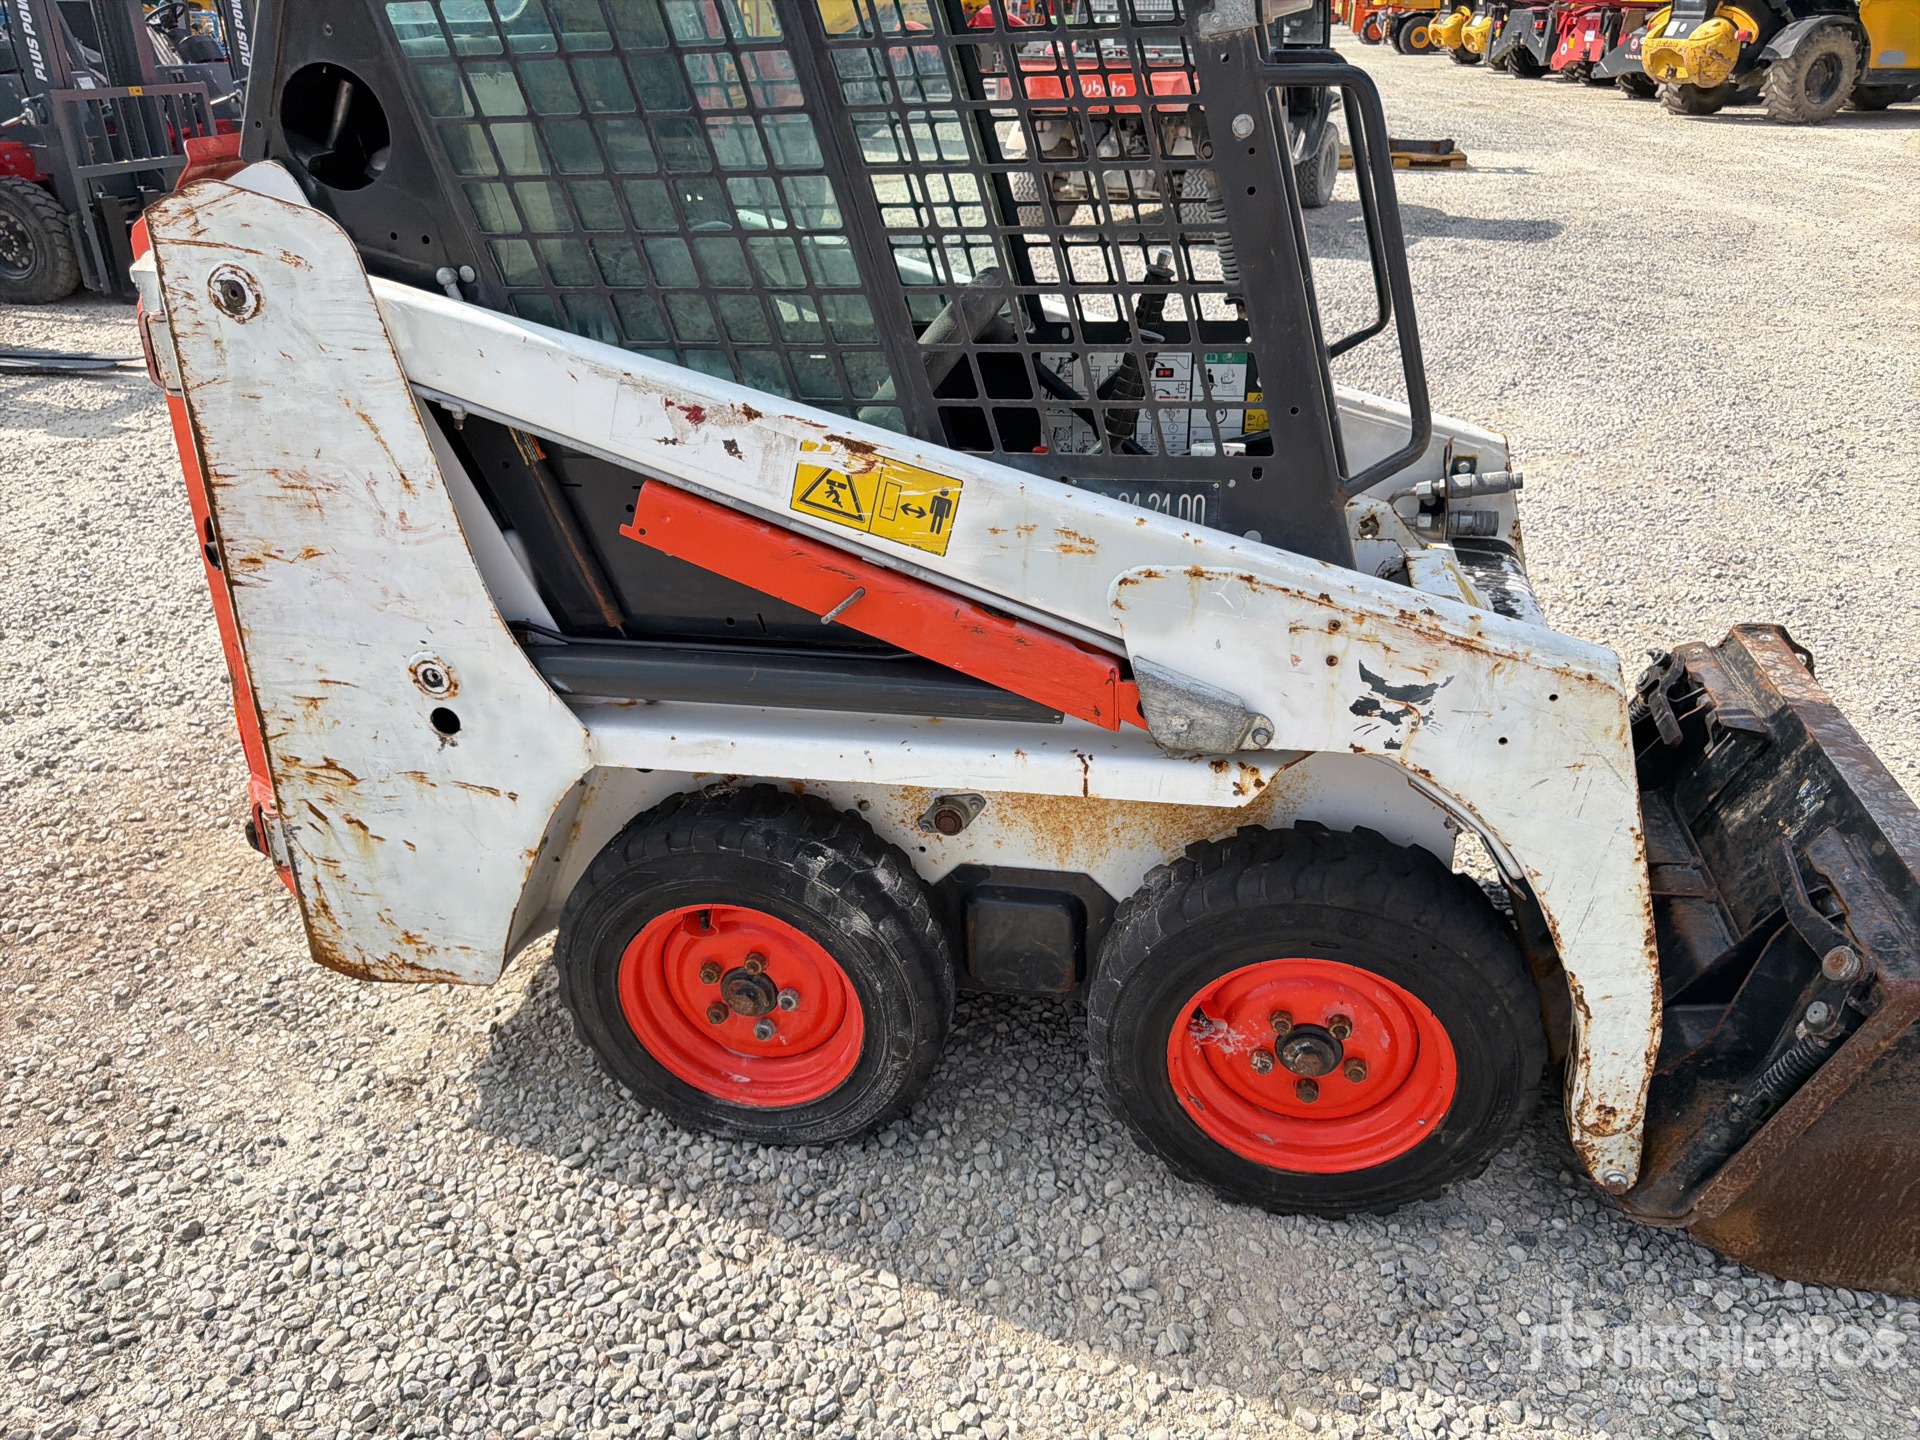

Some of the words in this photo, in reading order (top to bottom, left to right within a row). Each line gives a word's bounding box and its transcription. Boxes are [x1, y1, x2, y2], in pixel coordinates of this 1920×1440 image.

[26, 37, 48, 82] PLUS
[236, 30, 251, 67] PLUS
[1080, 80, 1127, 97] ubta
